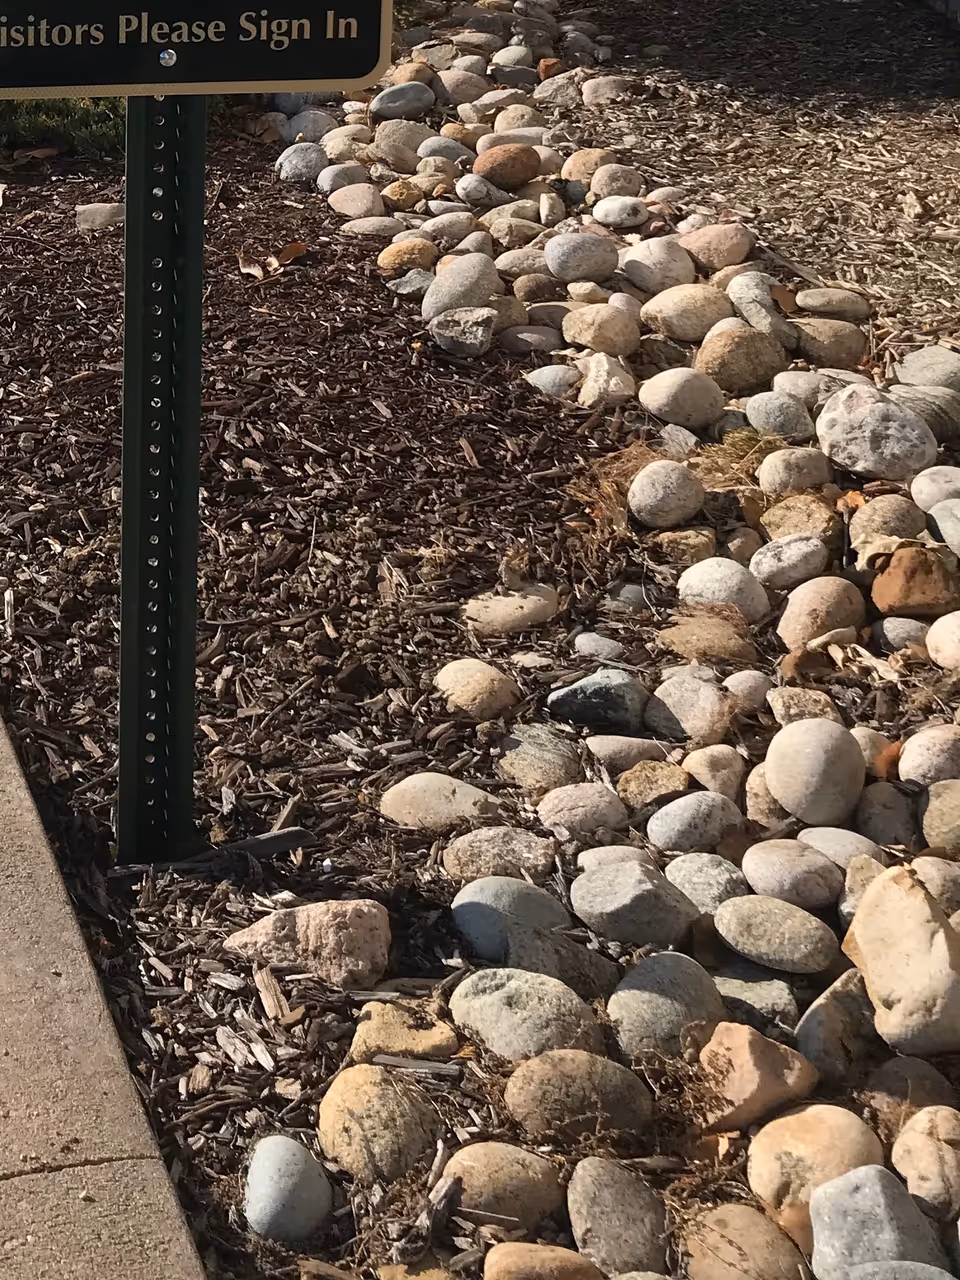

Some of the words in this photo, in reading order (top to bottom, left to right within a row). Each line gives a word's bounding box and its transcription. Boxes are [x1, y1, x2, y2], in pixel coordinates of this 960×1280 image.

[118, 11, 226, 44] Please
[239, 9, 311, 51] Sign
[326, 10, 358, 39] In
